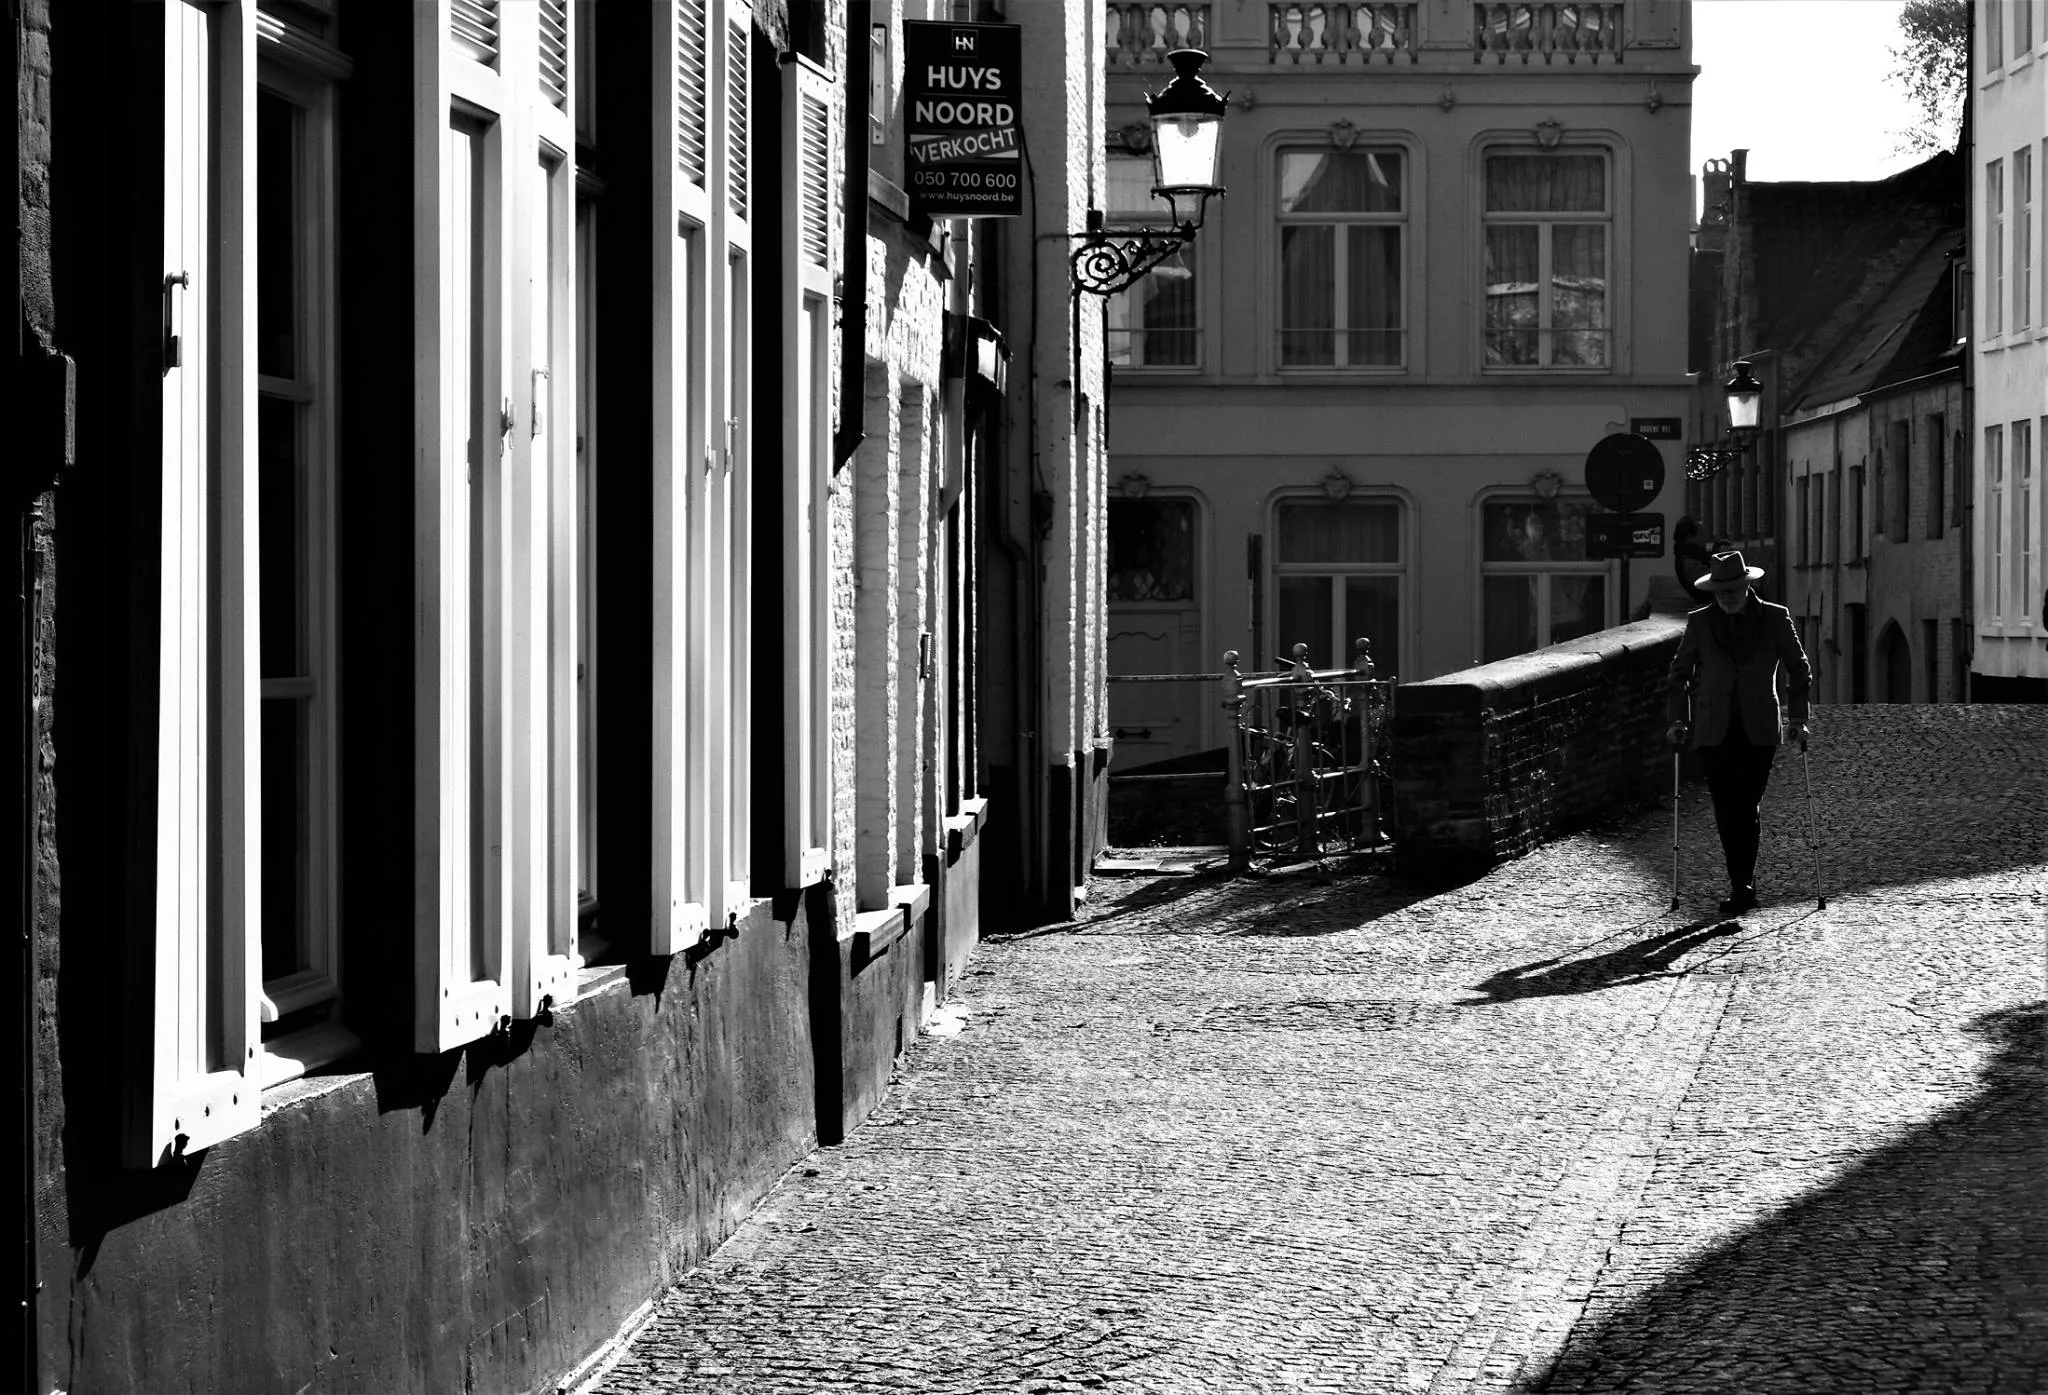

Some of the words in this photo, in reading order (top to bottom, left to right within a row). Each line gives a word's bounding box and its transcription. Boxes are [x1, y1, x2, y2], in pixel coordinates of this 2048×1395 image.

[927, 65, 1002, 90] HUYS
[915, 100, 1014, 126] NOORD
[913, 127, 1016, 164] VERKOCHT
[914, 171, 946, 186] 050
[949, 172, 981, 187] 700
[985, 173, 1017, 188] 600
[920, 190, 1015, 203] www.huysnoord.be
